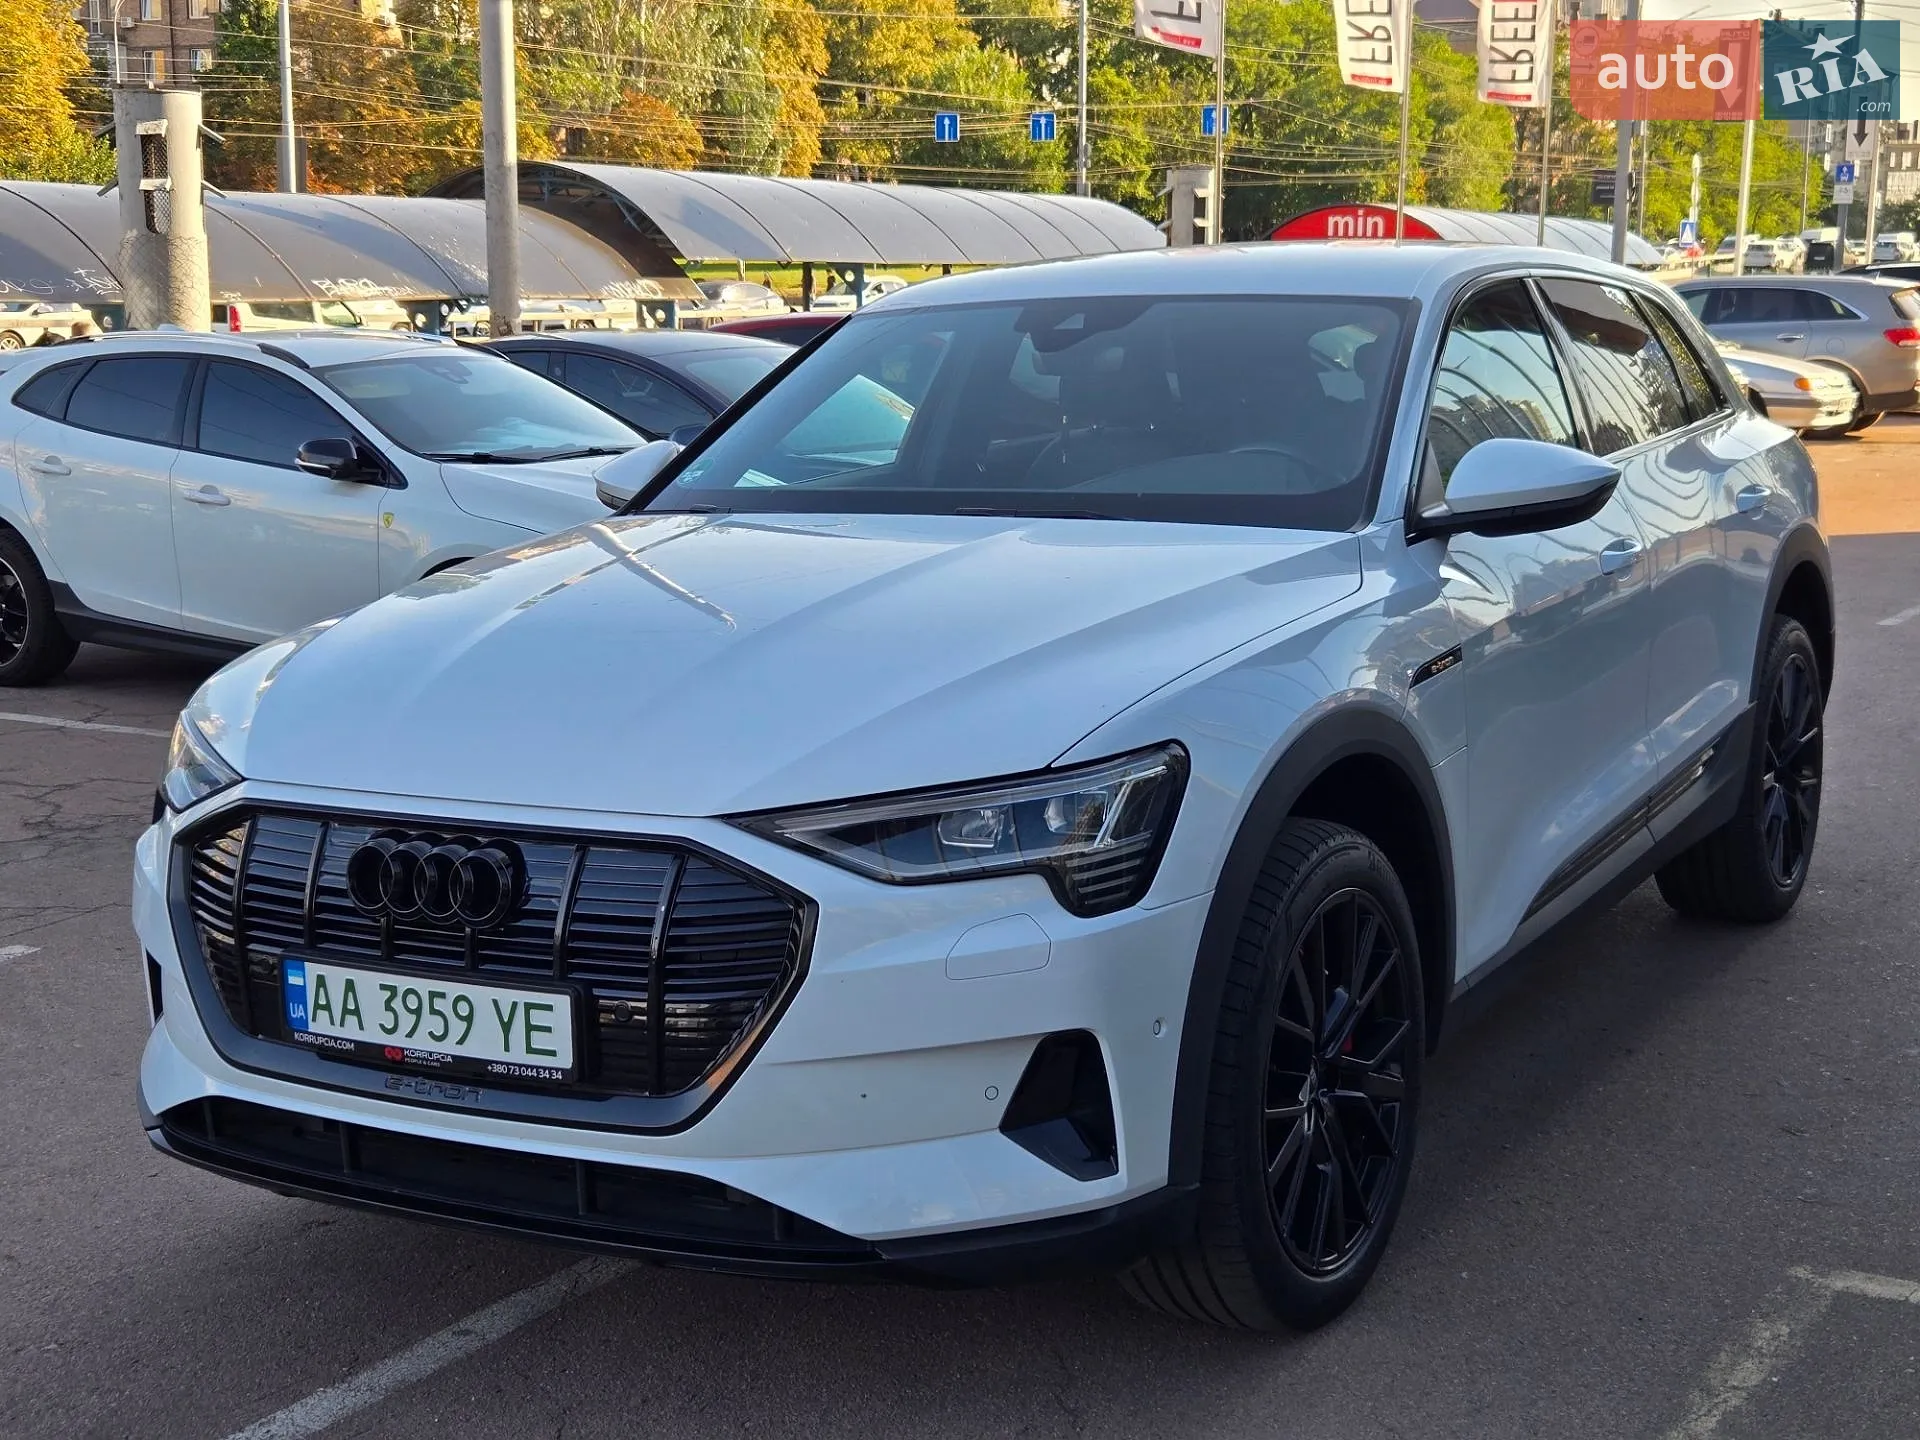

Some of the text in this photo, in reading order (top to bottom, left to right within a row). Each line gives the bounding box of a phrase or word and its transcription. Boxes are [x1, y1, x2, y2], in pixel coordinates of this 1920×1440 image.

[1328, 209, 1384, 237] min
[290, 1002, 306, 1020] UA
[312, 973, 557, 1057] AA 3959 YE
[294, 1031, 355, 1051] KORRUPCIA.COM
[404, 1049, 453, 1063] KORRUPCIA
[487, 1063, 562, 1080] +380 73 044 34 34
[384, 1075, 483, 1103] e-tron
